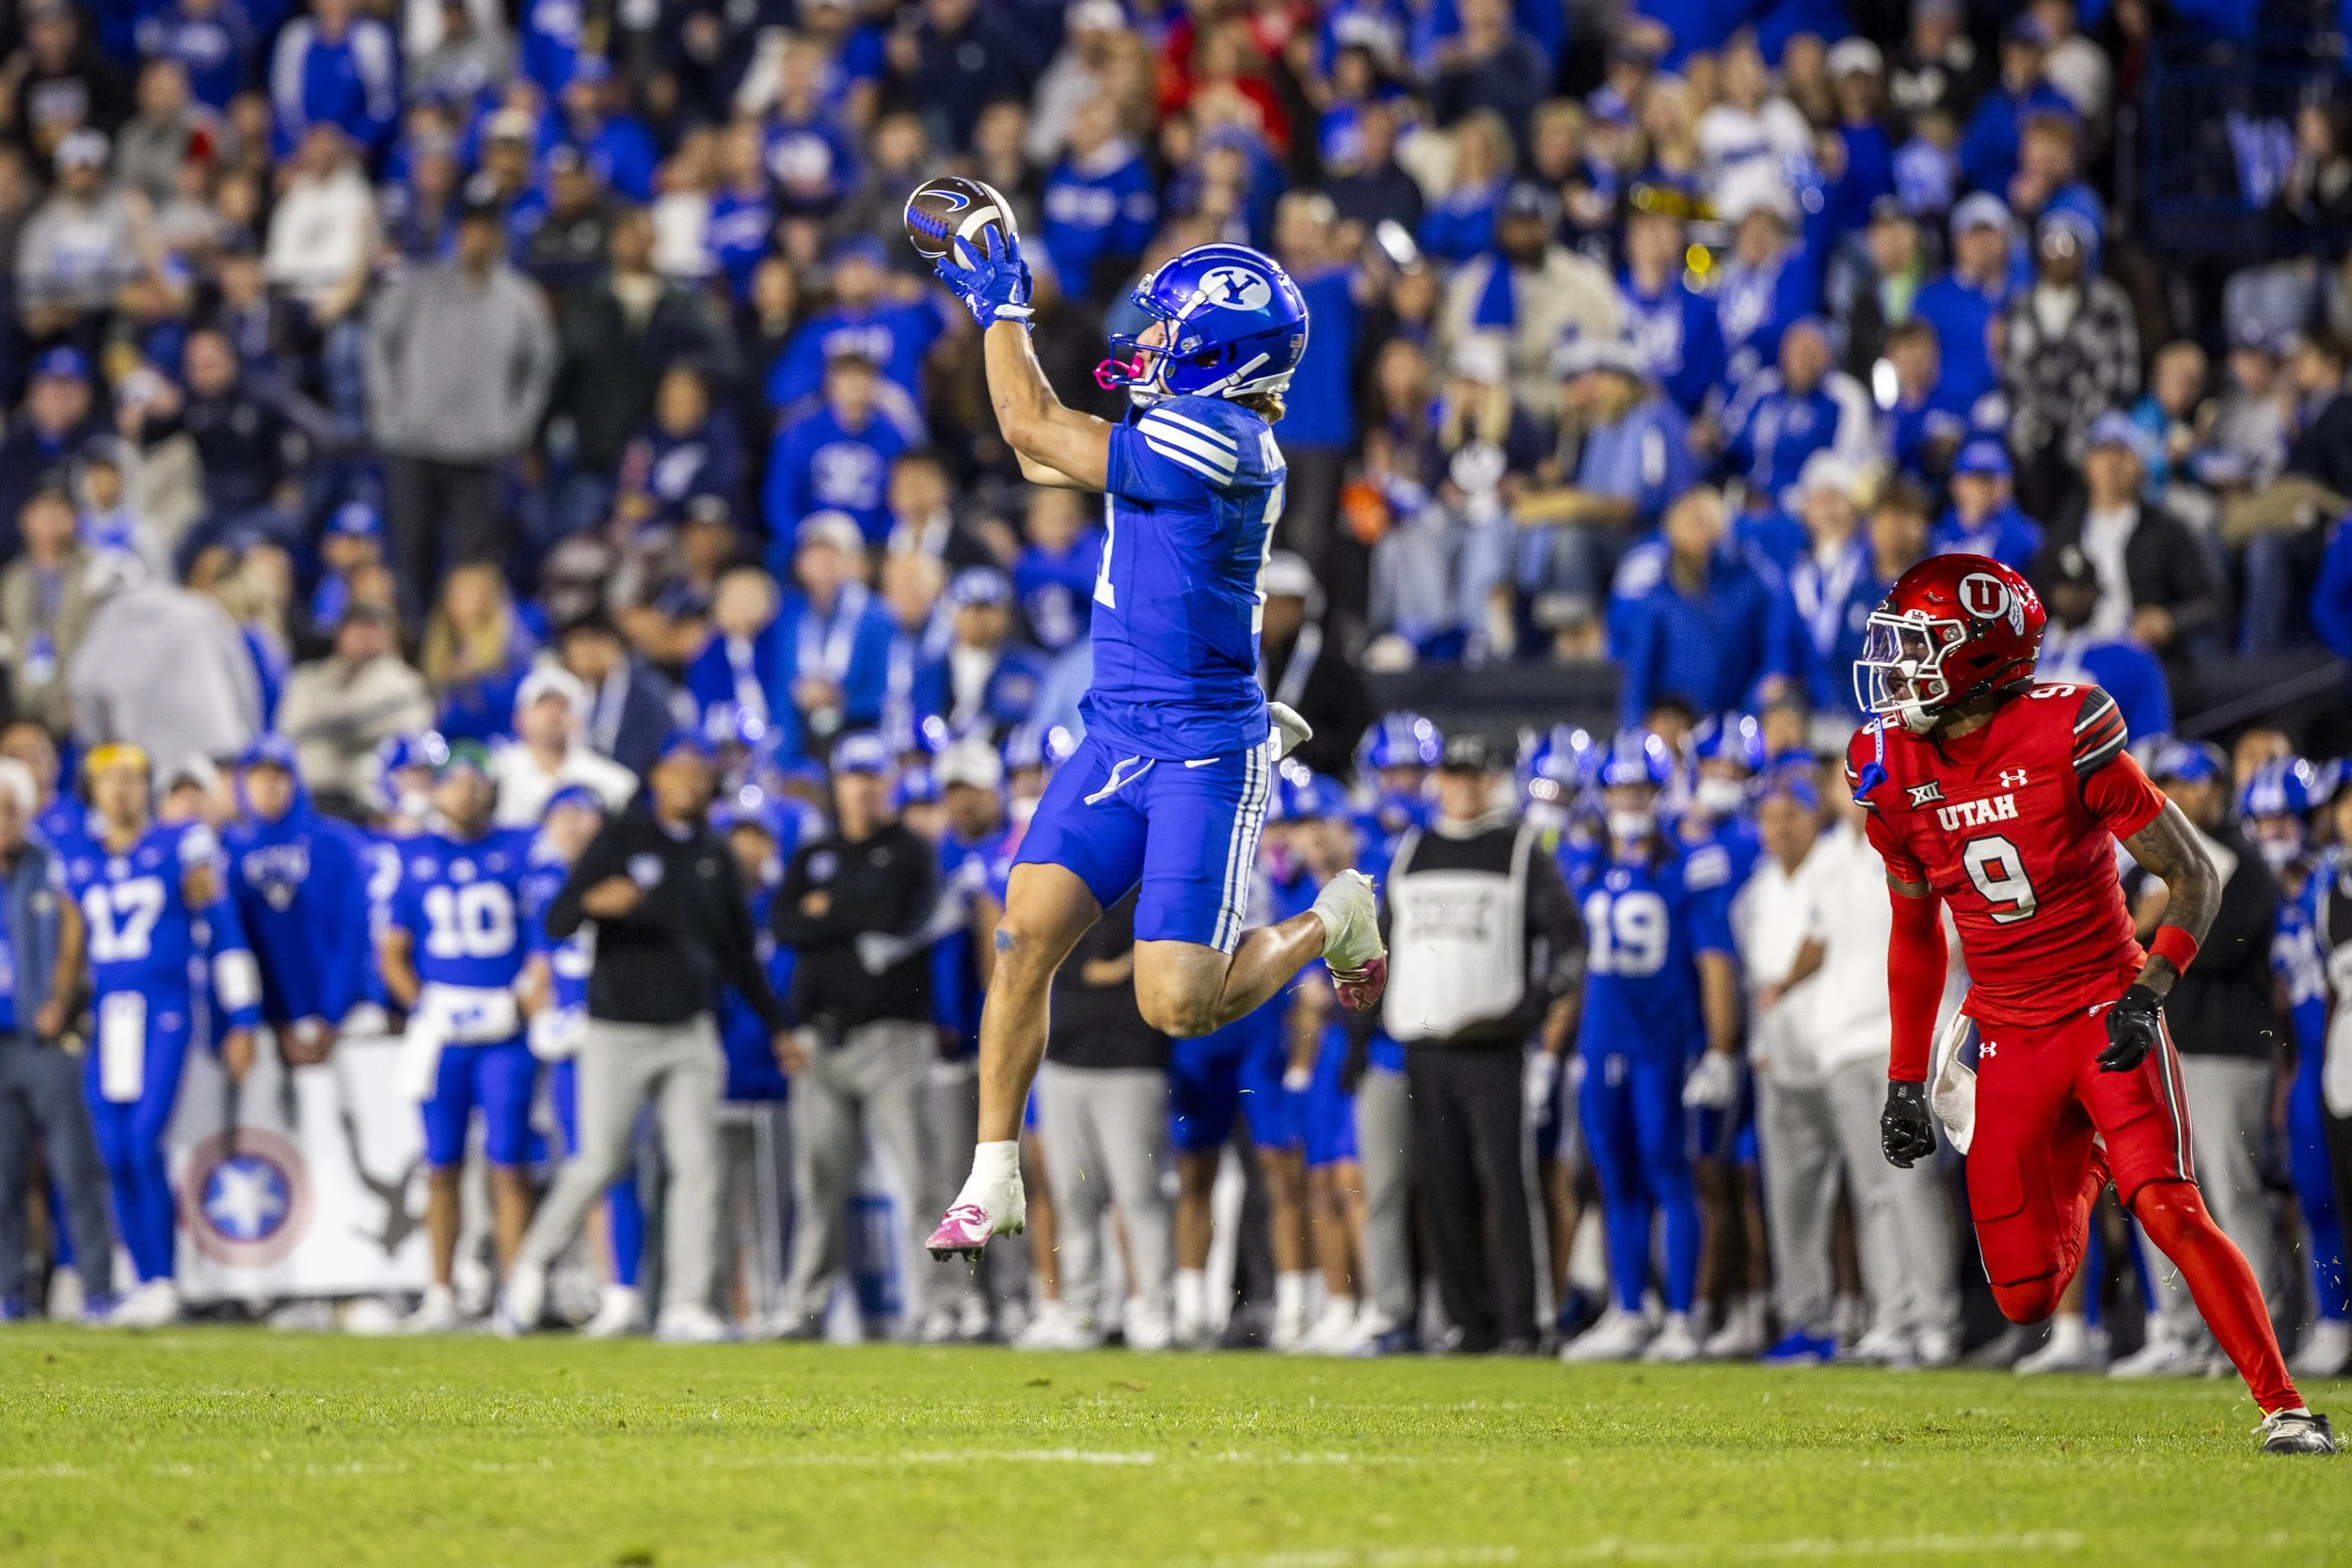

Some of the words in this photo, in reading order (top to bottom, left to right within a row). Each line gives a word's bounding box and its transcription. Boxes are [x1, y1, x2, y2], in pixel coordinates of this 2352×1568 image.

[1211, 269, 1262, 306] Y
[1965, 578, 2002, 613] U
[2029, 684, 2077, 699] 9
[1906, 780, 1946, 809] XII
[1935, 793, 2019, 832] UTAH
[1963, 832, 2039, 925] 9
[82, 875, 167, 964] 17
[423, 880, 517, 960] 10
[1583, 889, 1670, 978] 19
